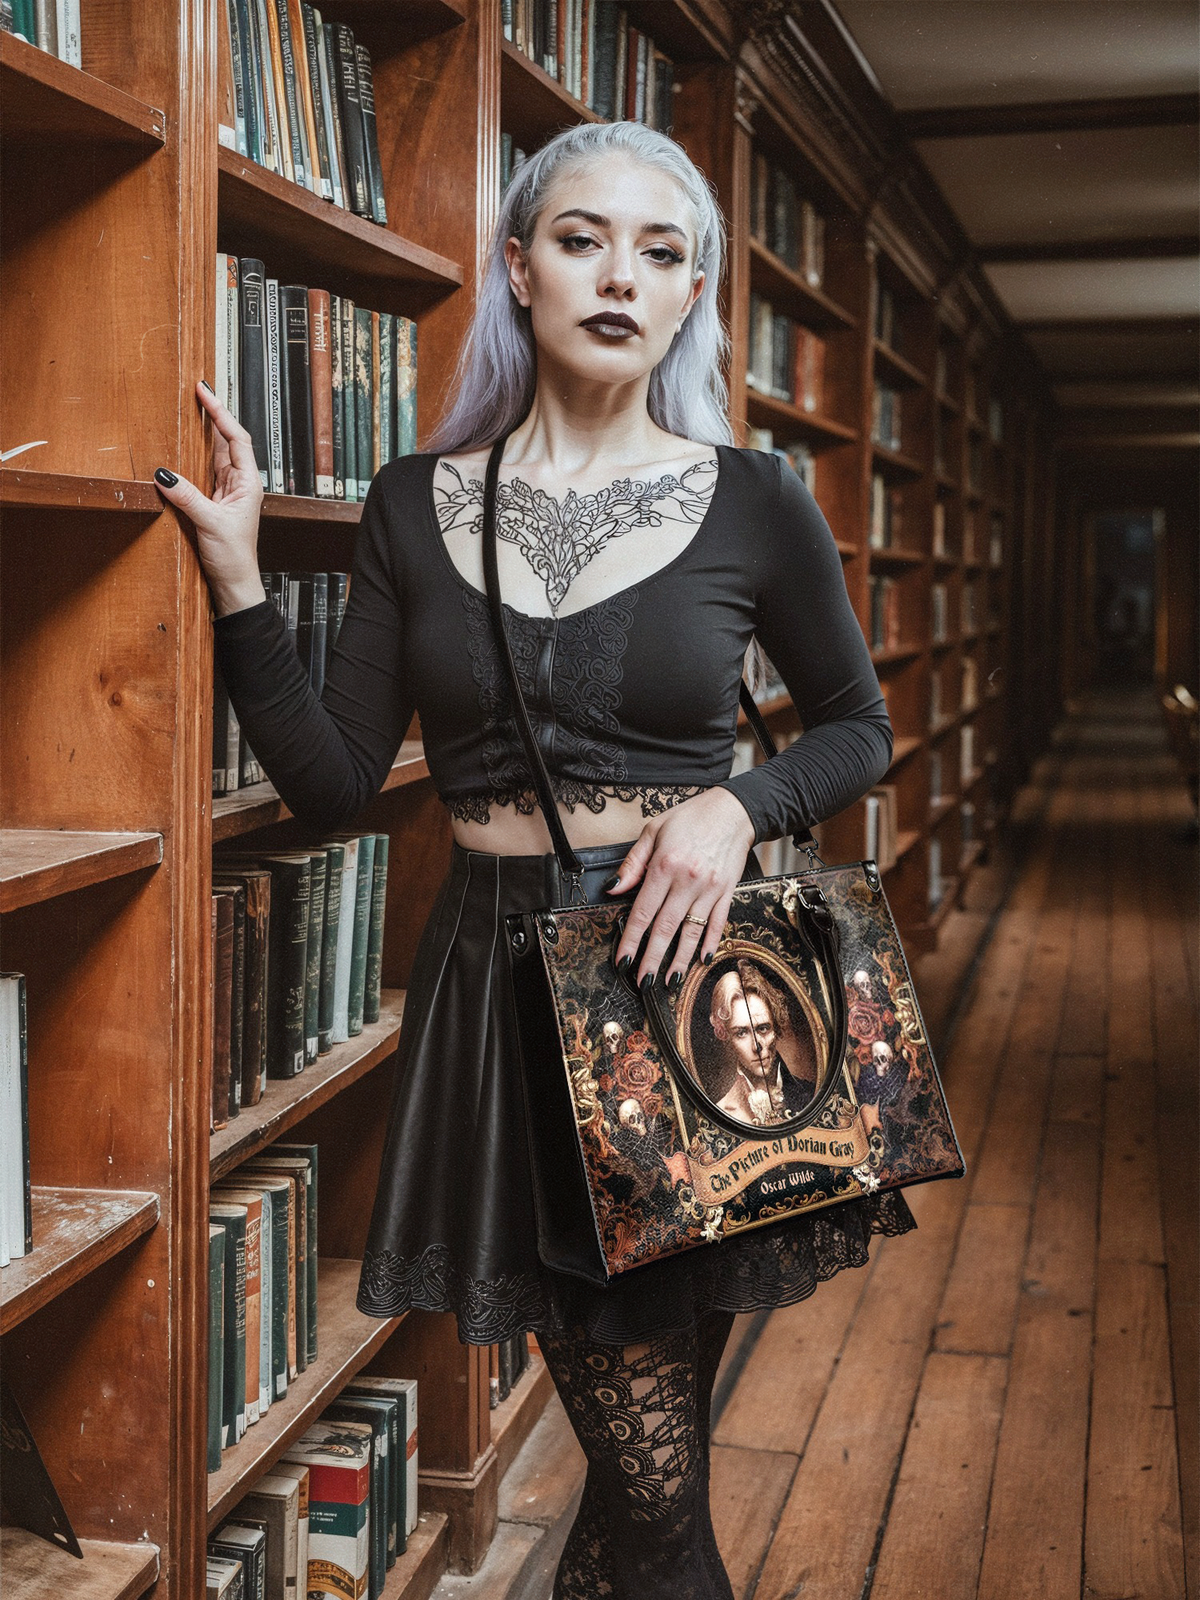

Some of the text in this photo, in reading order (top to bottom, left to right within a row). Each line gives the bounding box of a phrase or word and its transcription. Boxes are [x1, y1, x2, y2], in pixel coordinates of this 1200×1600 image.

[709, 1133, 855, 1193] The Picture of Dorian Gray
[760, 1170, 815, 1195] Oscar Wilde
